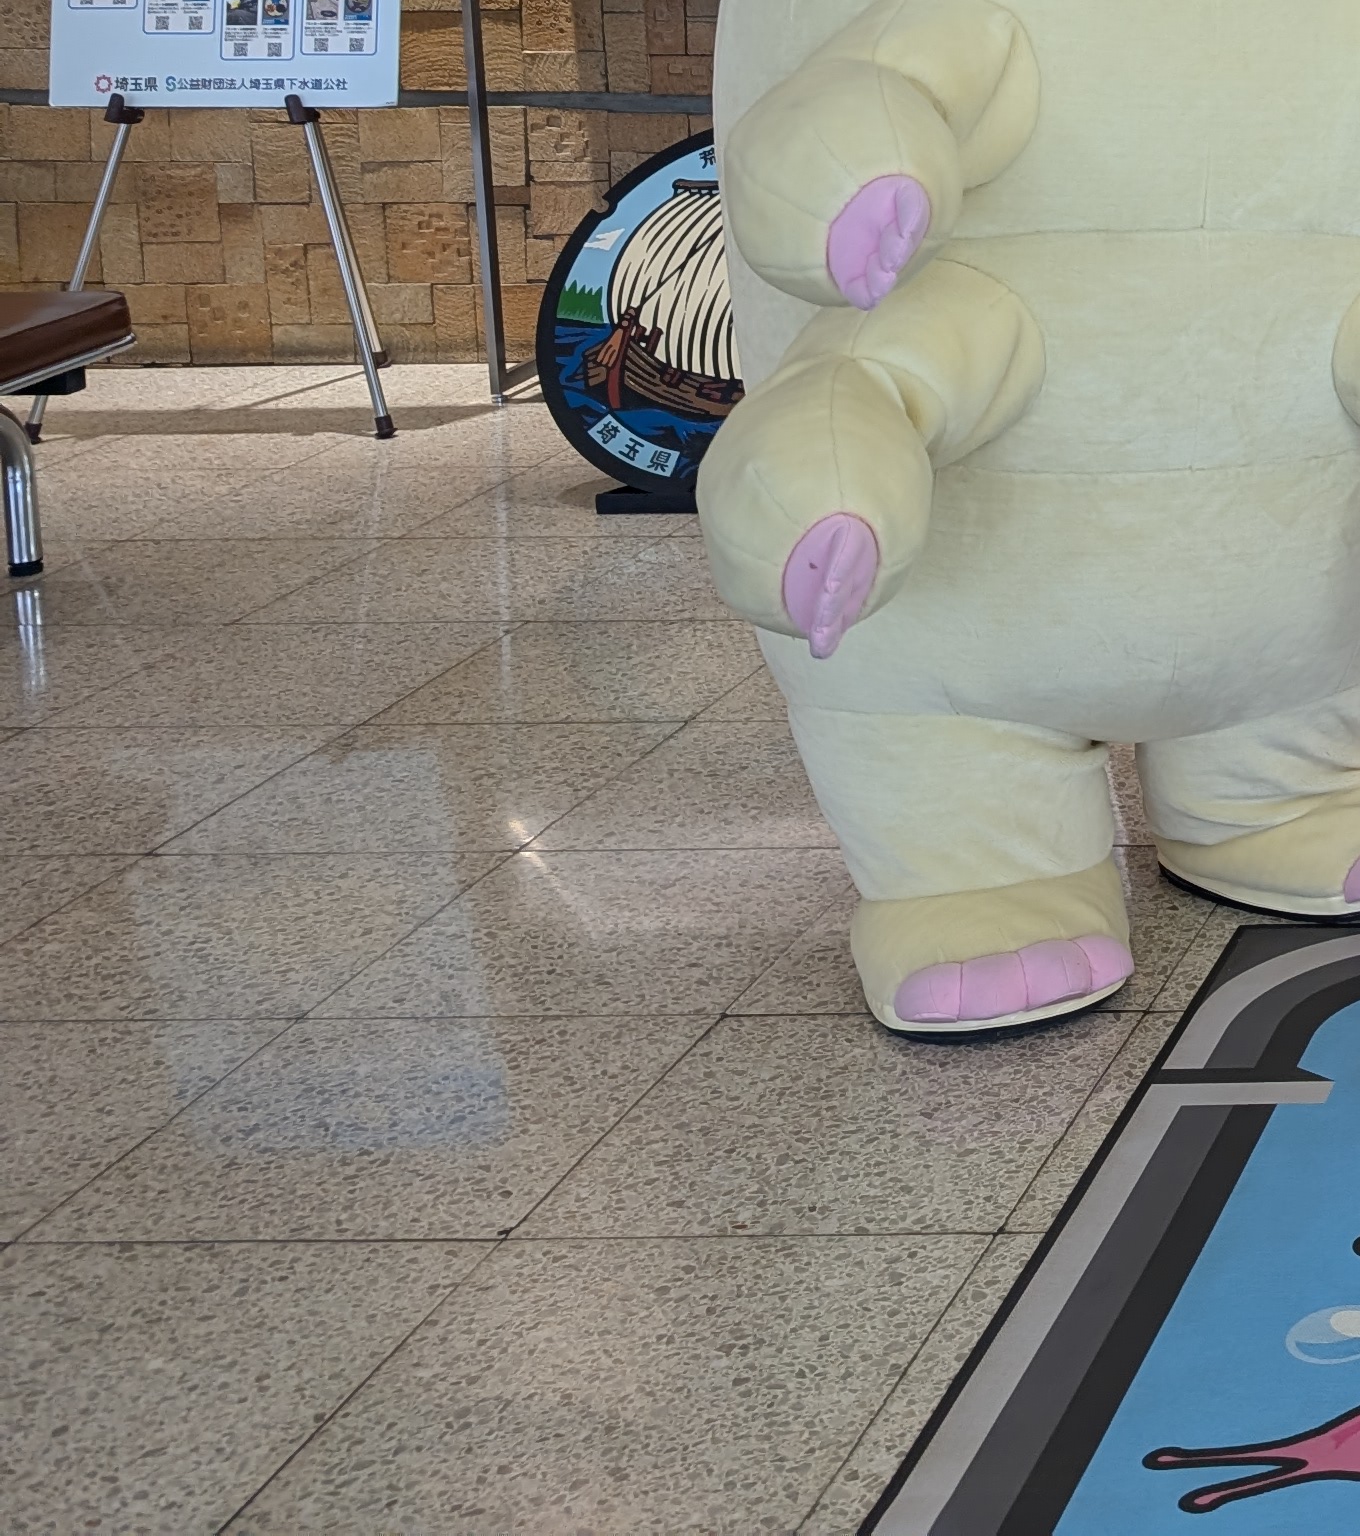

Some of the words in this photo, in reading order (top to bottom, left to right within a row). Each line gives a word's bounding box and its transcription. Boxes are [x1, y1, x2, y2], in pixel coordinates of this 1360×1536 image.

[114, 77, 158, 92] 埼玉県
[596, 421, 671, 473] 埼玉県
